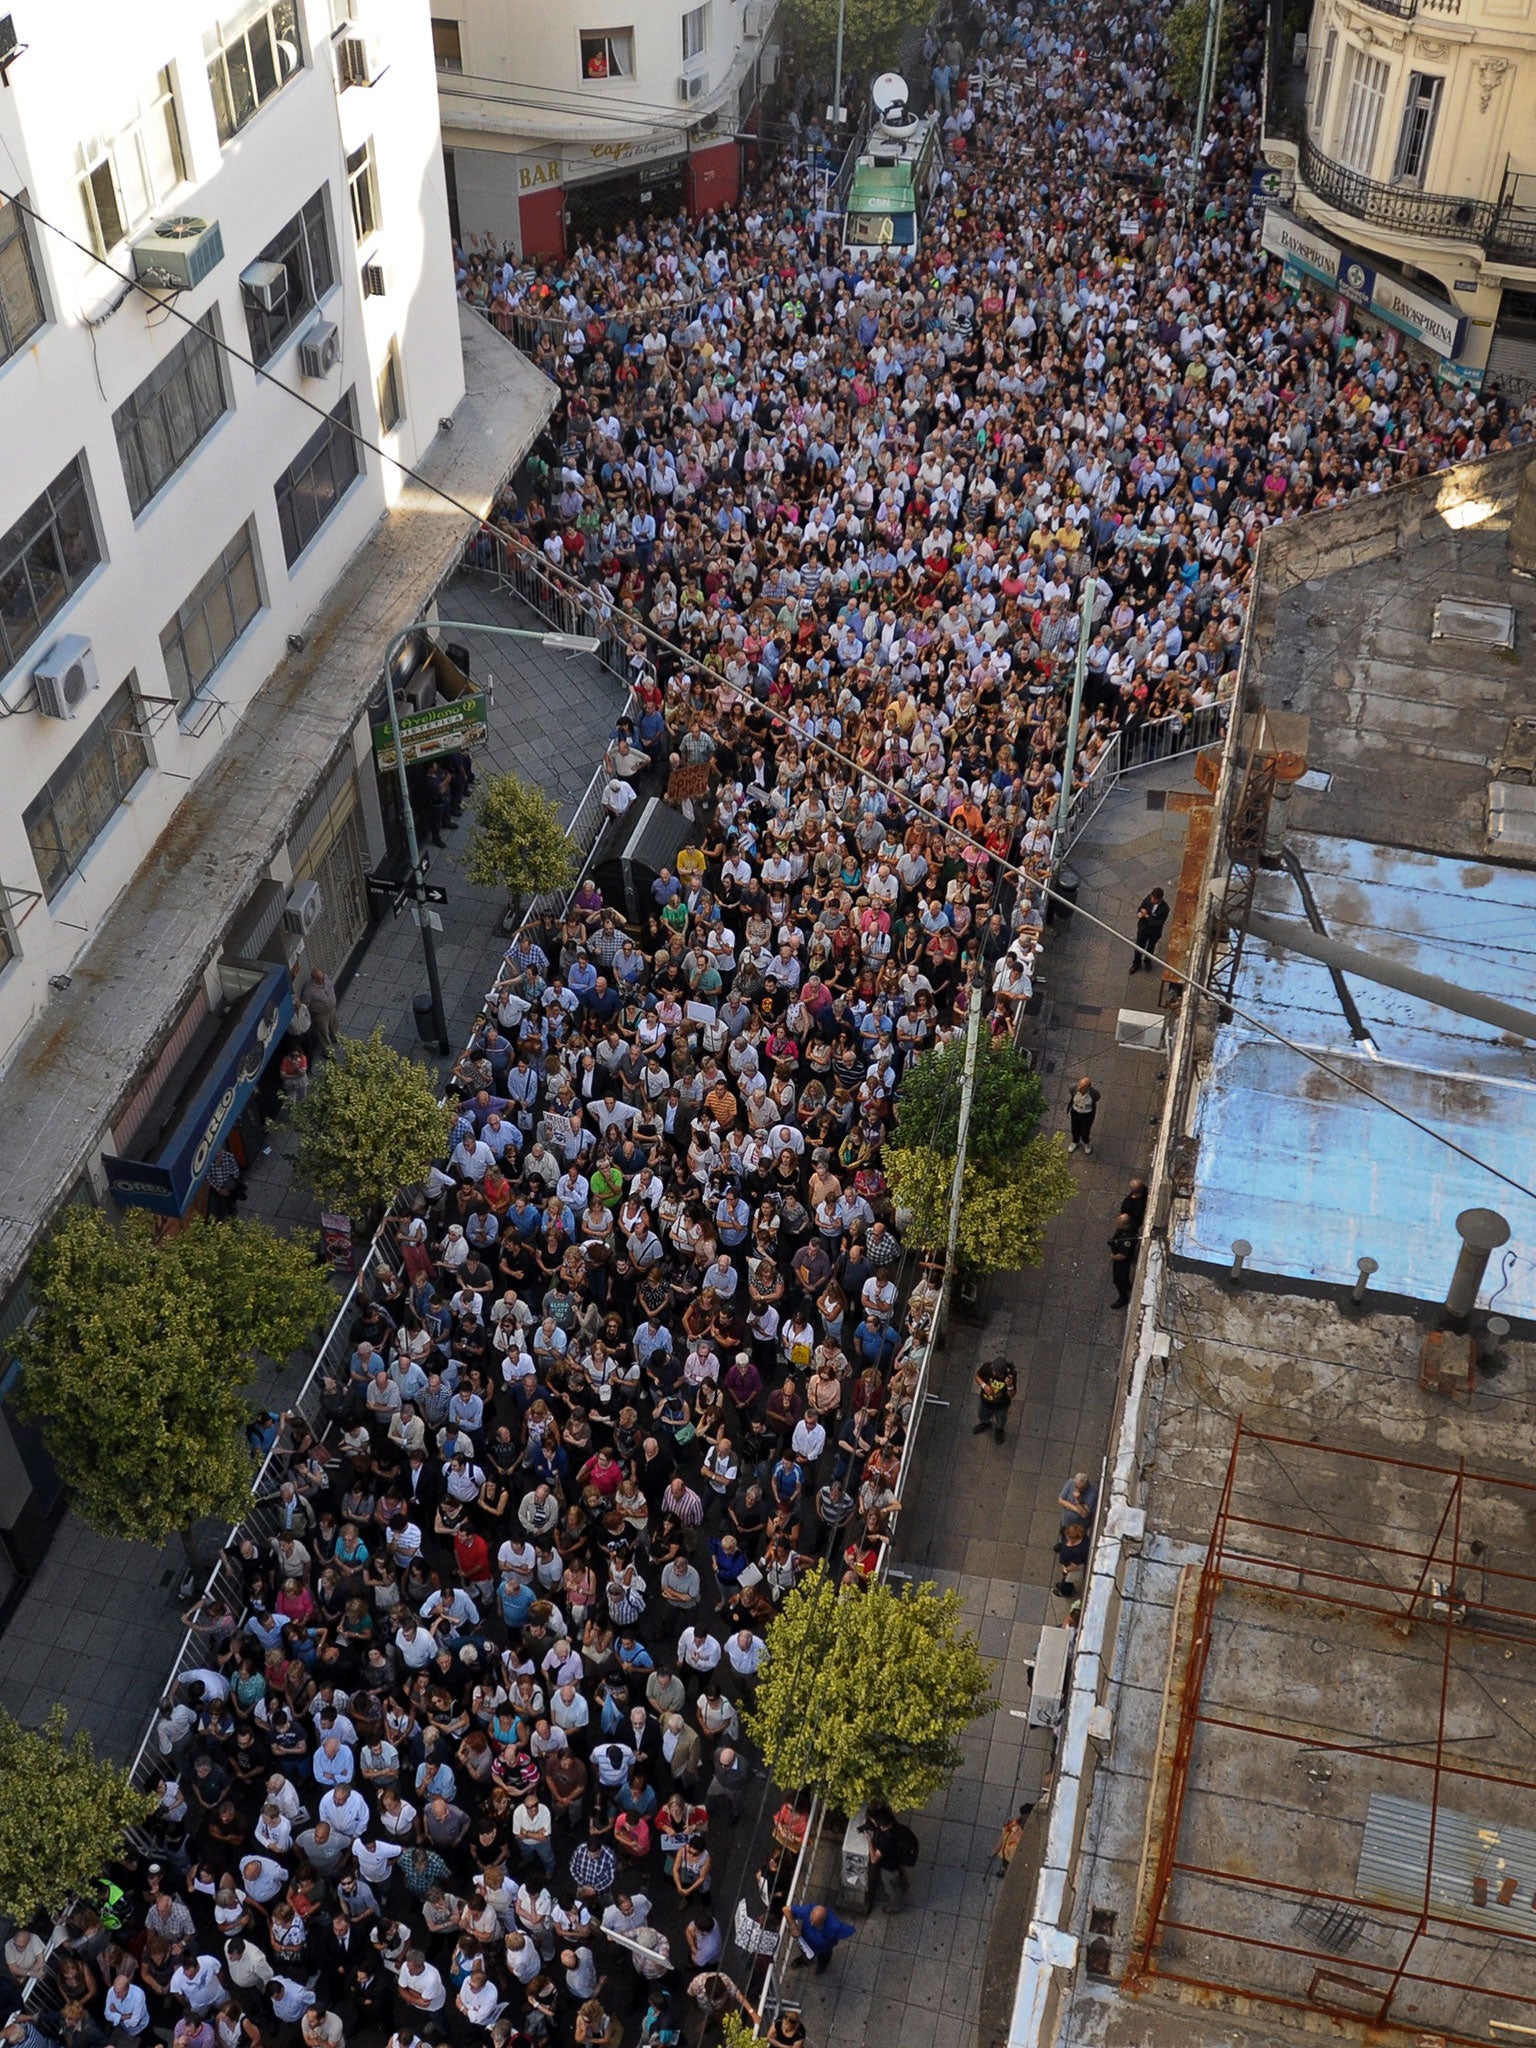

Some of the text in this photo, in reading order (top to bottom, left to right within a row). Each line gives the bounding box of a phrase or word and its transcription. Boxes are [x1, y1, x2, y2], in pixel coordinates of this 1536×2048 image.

[519, 160, 560, 188] BAR
[1281, 230, 1336, 275] BAYASPIRINA
[1392, 295, 1452, 344] BAYASPIRINA
[401, 706, 460, 730] Avellano
[193, 1089, 233, 1174] OREO
[116, 1181, 170, 1196] OREO
